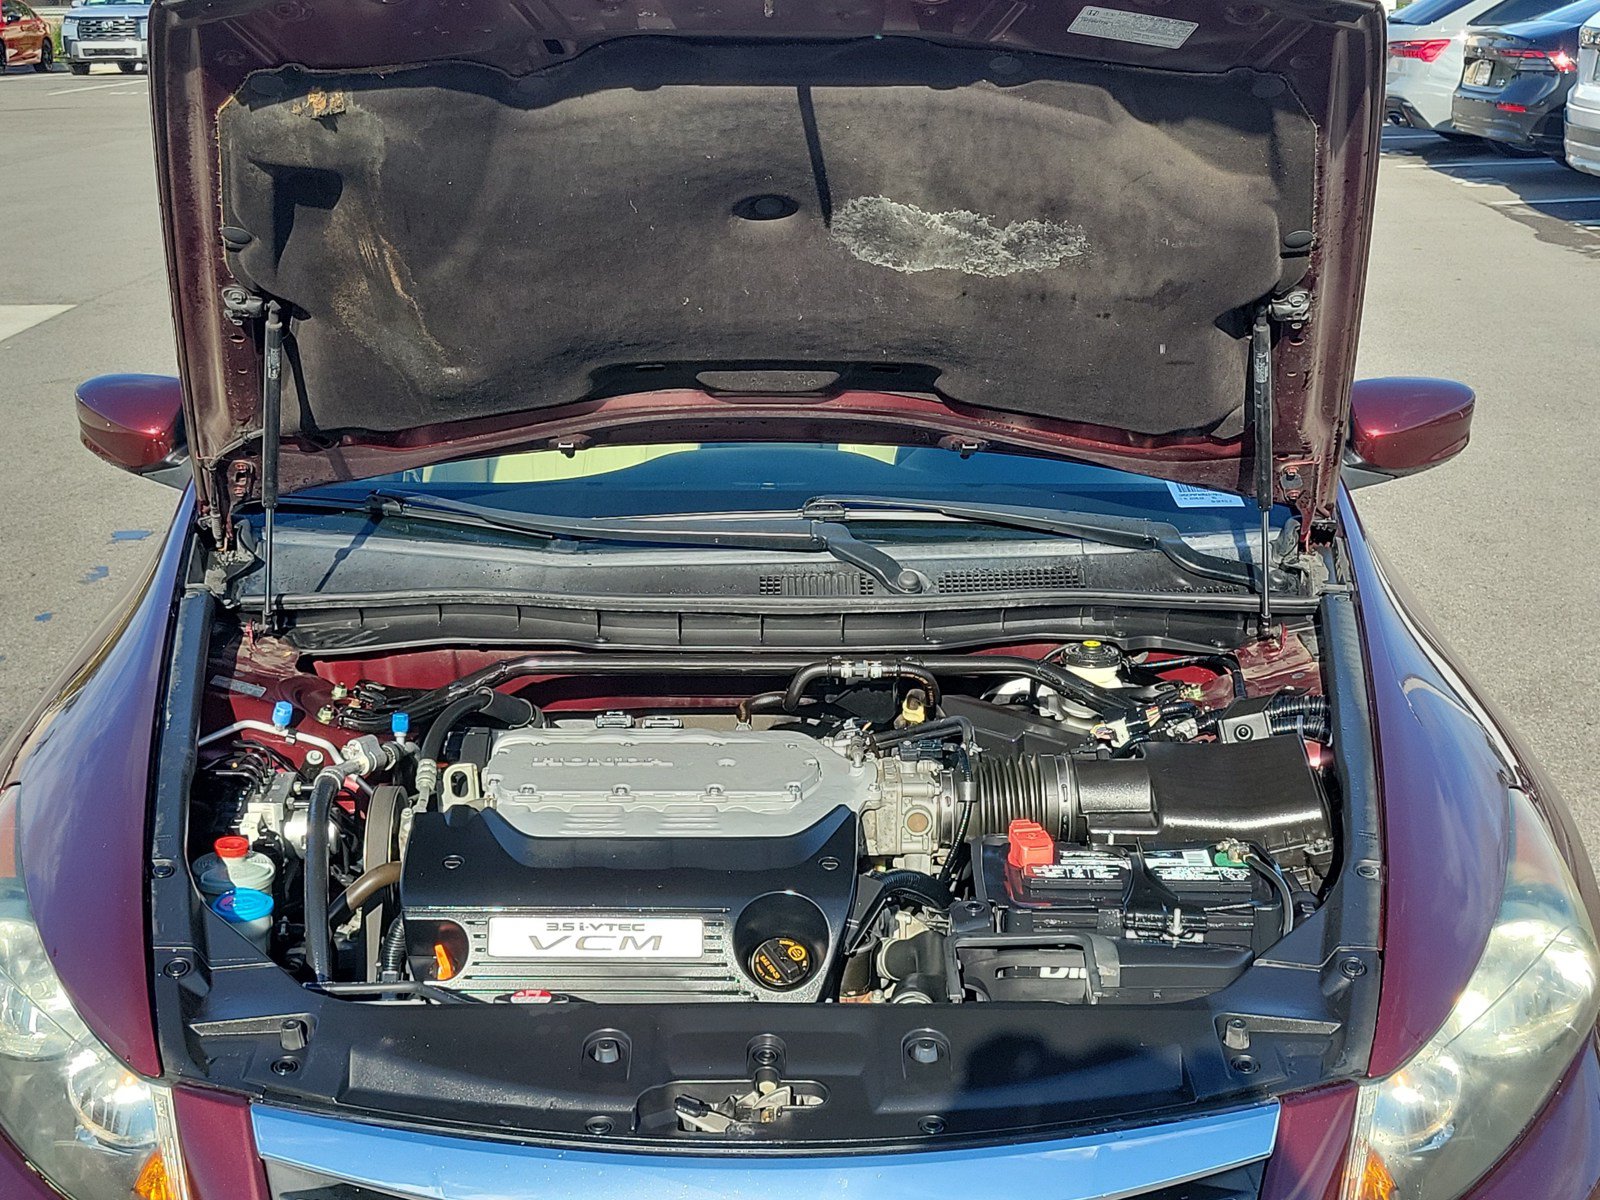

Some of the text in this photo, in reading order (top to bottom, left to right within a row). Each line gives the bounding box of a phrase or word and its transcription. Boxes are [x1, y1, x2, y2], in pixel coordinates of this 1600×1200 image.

[546, 922, 646, 932] 3.5 i-VTEC
[528, 935, 663, 951] VCM
